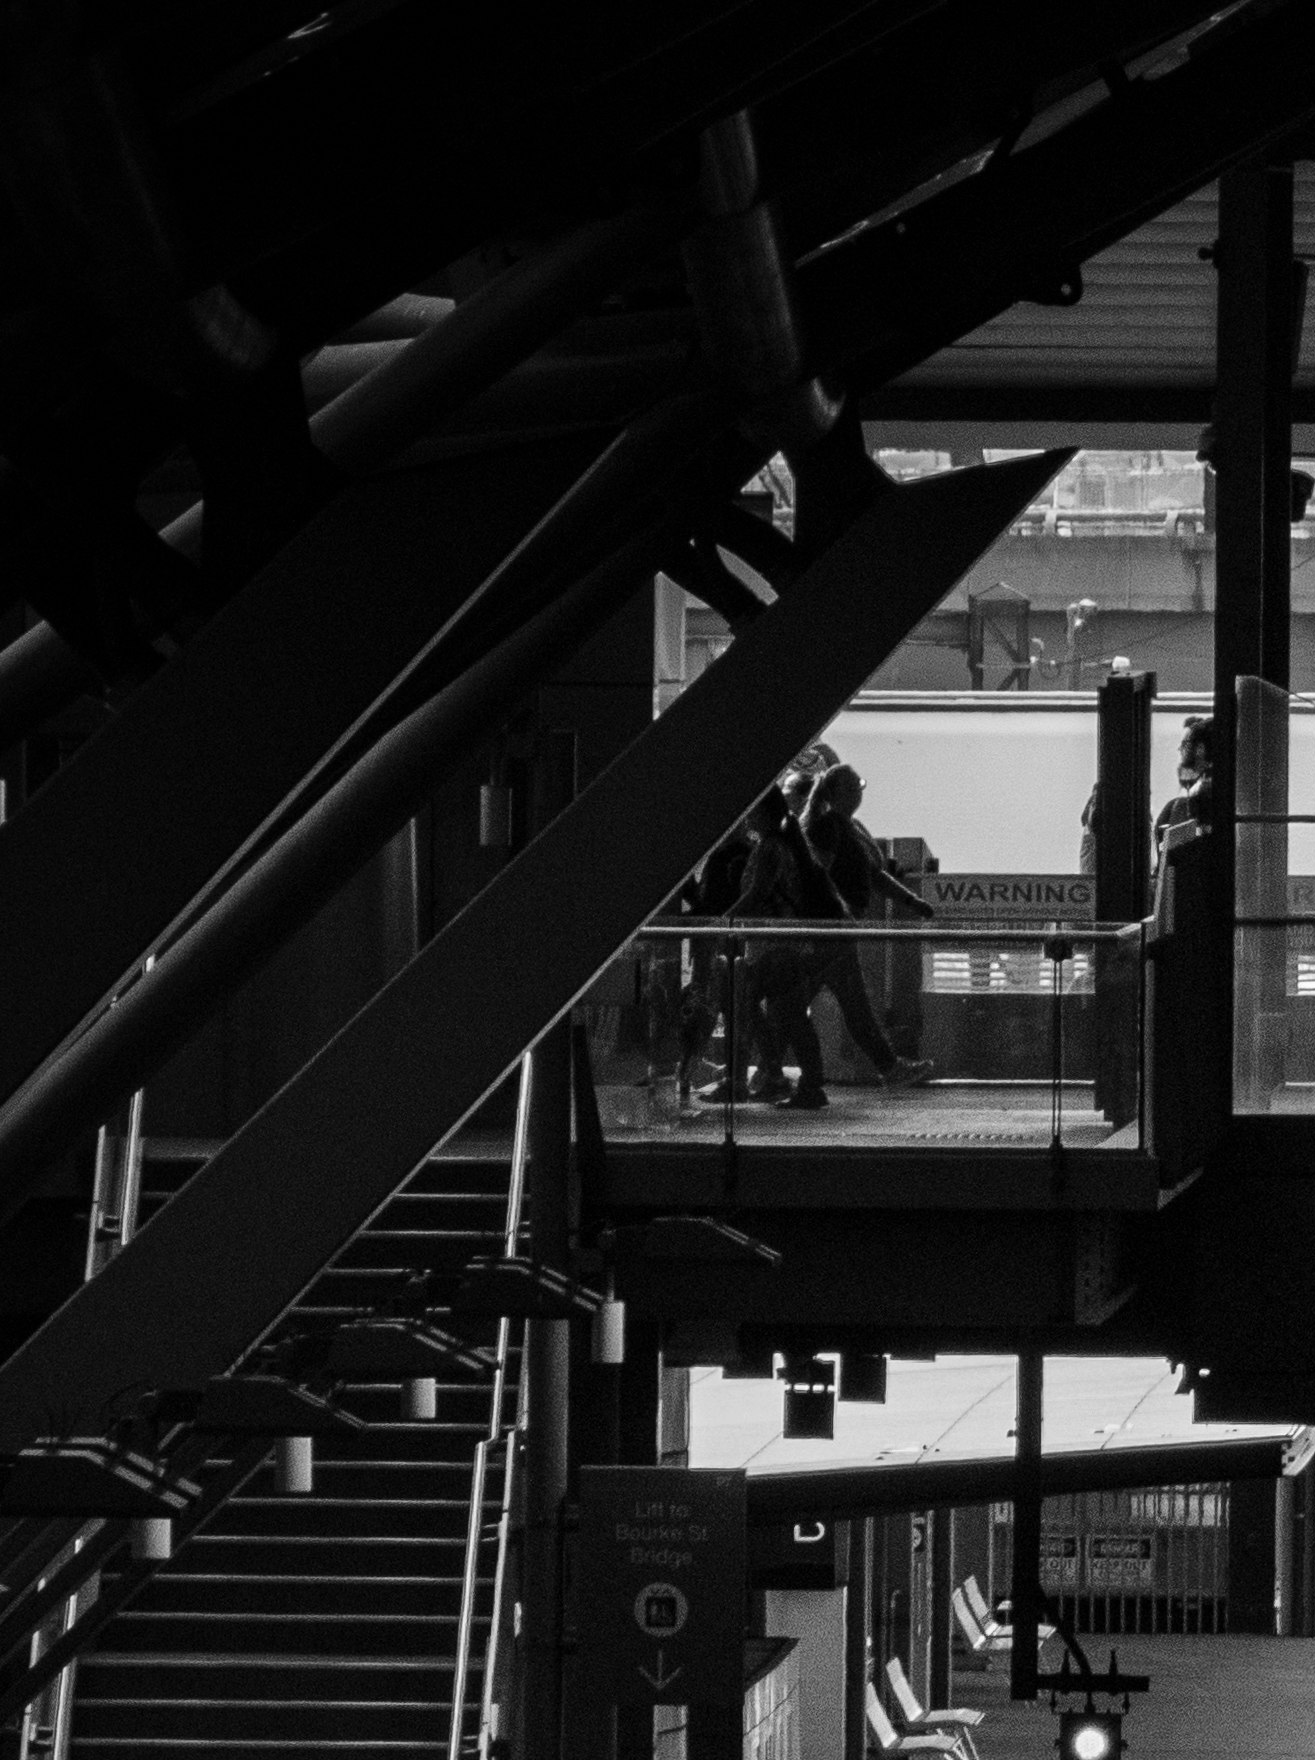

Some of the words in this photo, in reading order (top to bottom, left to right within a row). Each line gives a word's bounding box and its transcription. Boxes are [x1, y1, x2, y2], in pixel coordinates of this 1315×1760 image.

[935, 883, 1091, 903] WARNING
[635, 1502, 664, 1518] Lift
[669, 1503, 691, 1518] to
[615, 1523, 683, 1542] Bourke
[688, 1523, 709, 1542] St
[630, 1547, 693, 1571] Bridge
